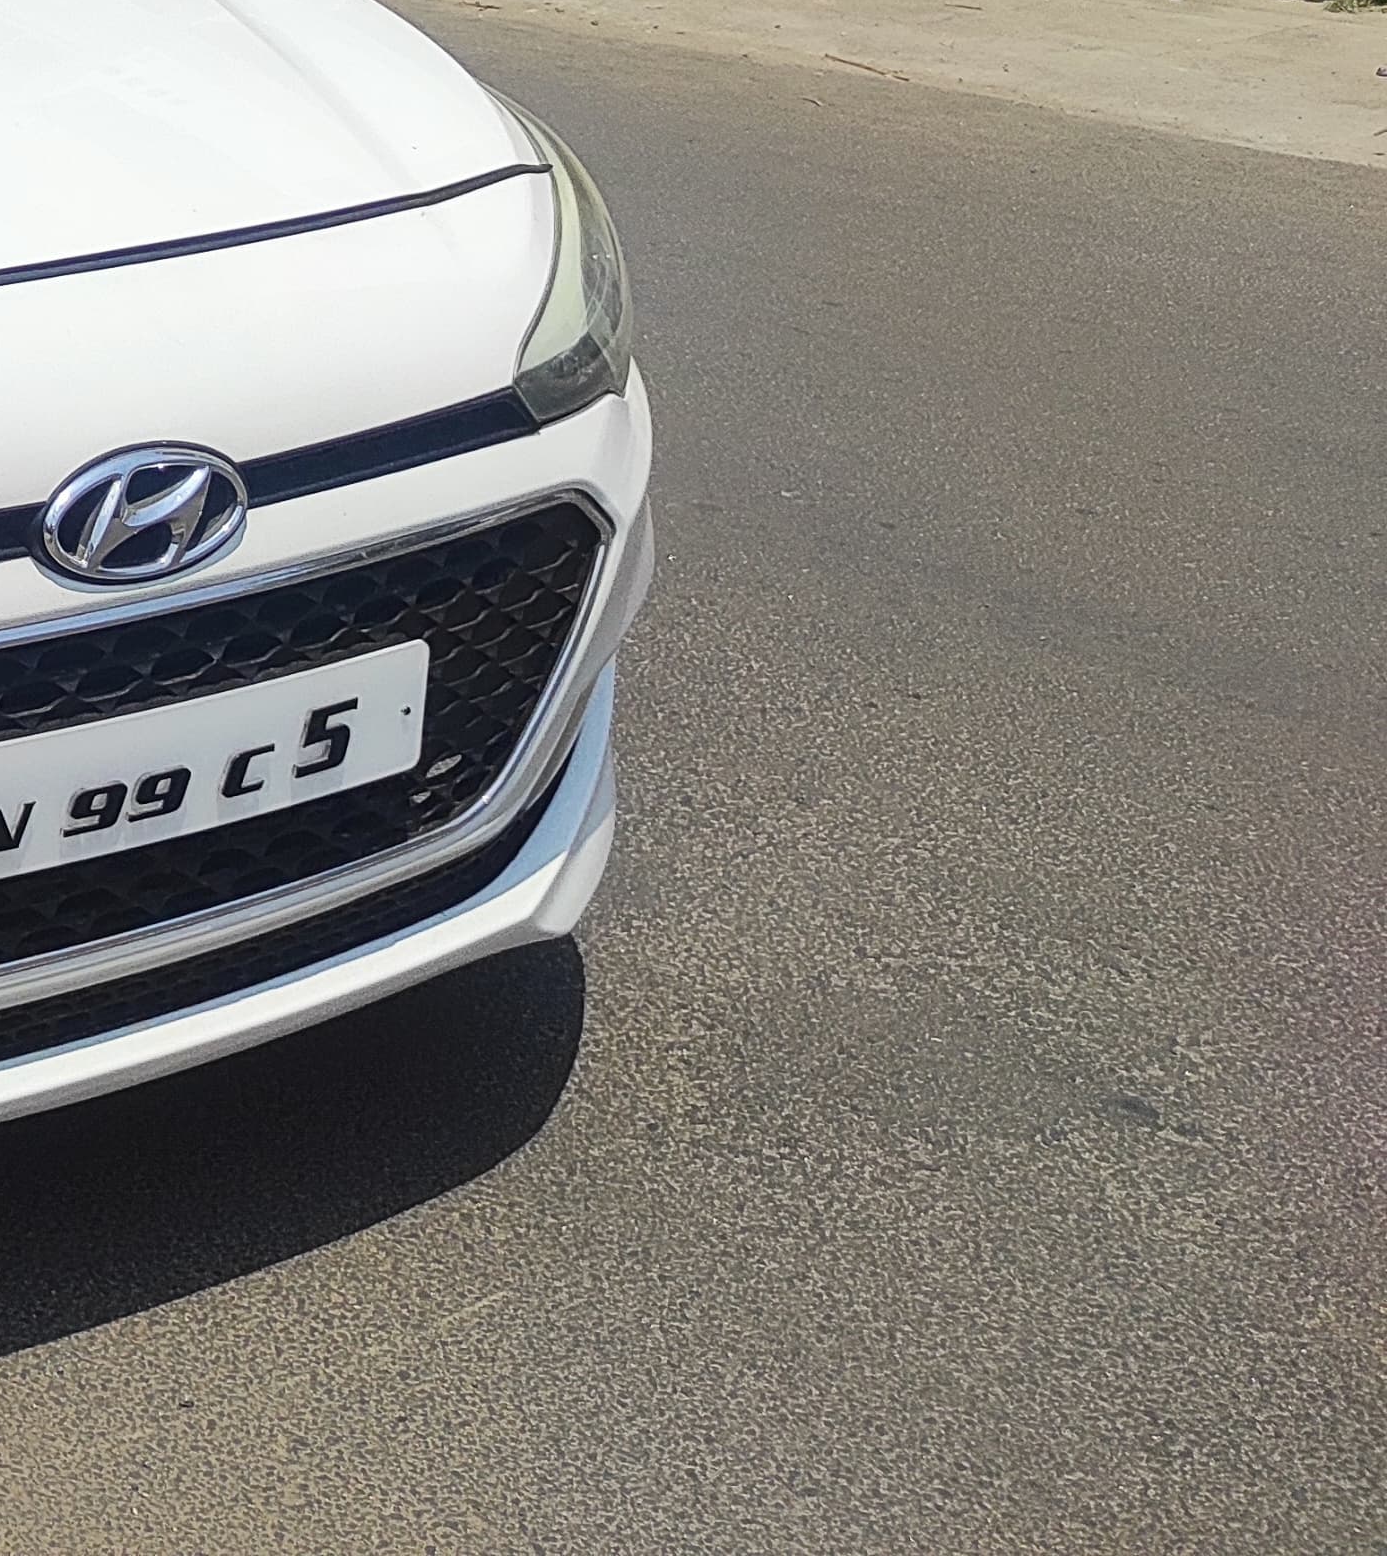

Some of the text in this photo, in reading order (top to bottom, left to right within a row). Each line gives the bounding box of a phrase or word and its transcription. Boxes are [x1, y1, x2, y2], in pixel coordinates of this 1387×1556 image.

[61, 765, 191, 837] 99
[221, 743, 275, 798] C
[294, 697, 358, 779] 5
